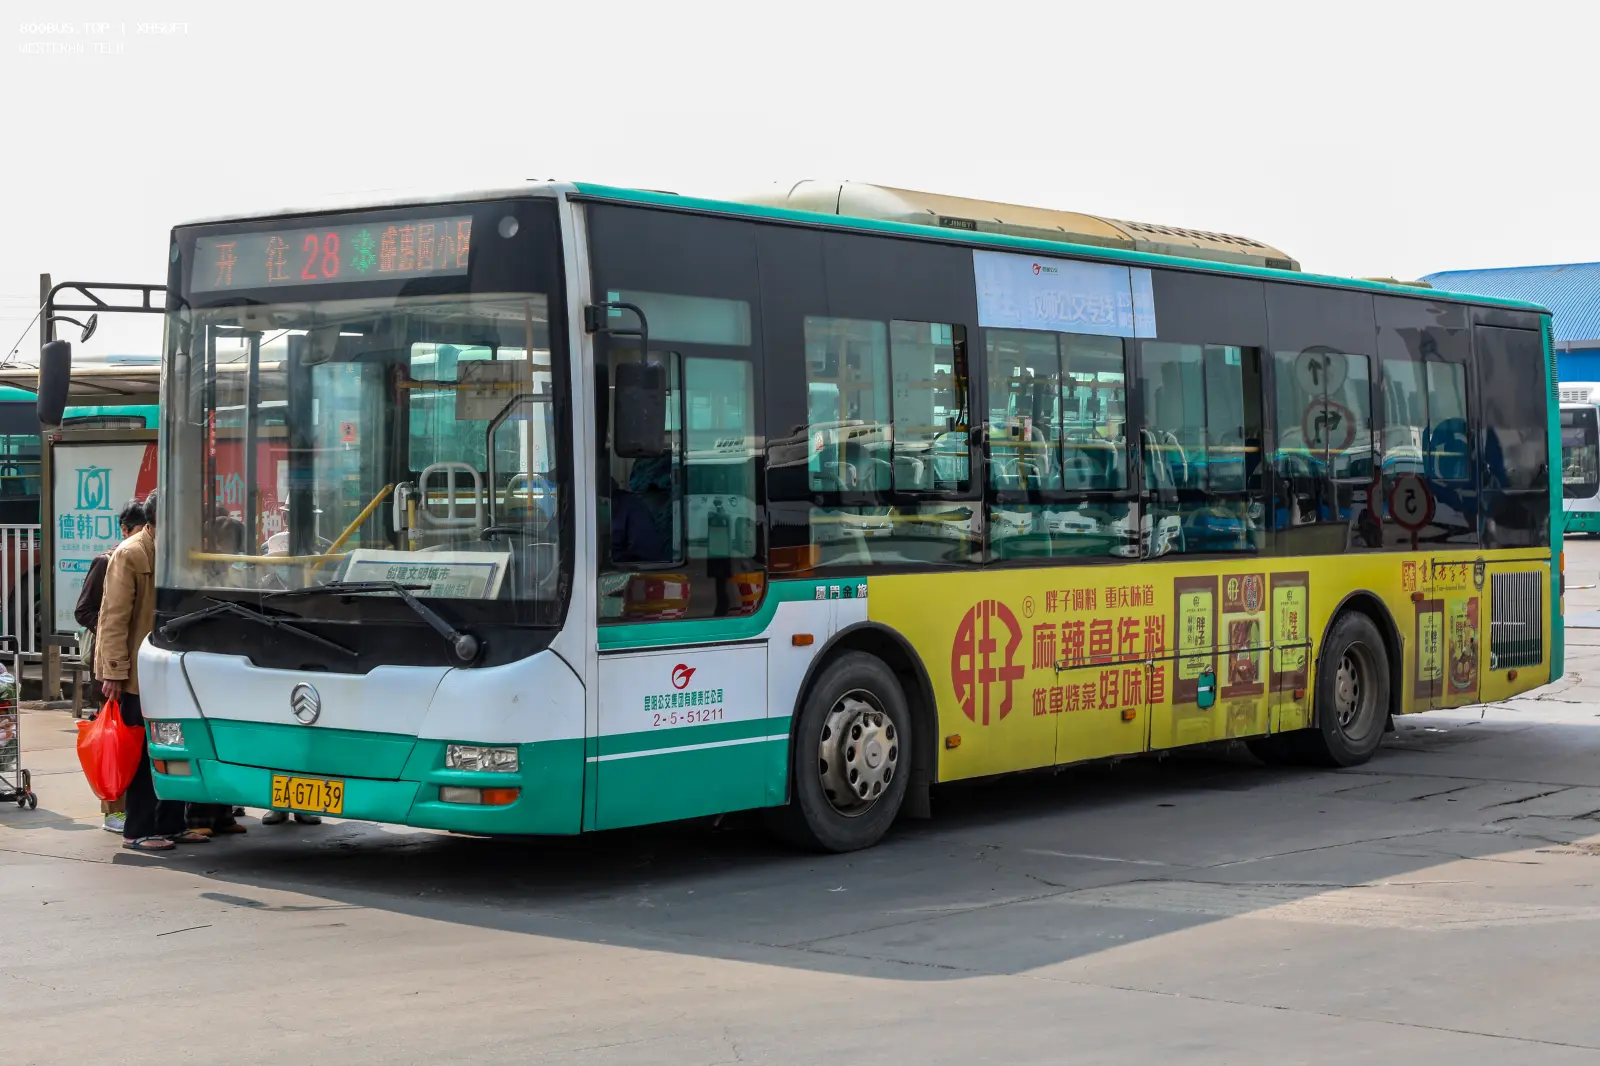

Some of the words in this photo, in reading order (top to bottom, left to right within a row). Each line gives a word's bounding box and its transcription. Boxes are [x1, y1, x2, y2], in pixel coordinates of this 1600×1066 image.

[301, 233, 340, 280] 28
[386, 566, 450, 581] 创建文明城市
[1045, 588, 1097, 613] 胖子调料
[1105, 584, 1154, 609] 重庆味道
[1032, 614, 1165, 670] 麻辣鱼佐料
[644, 688, 723, 711] 昆明公交集团有限责任公司
[1032, 665, 1165, 716] 做鱼烧菜好味道
[653, 707, 723, 727] 2-5-51211
